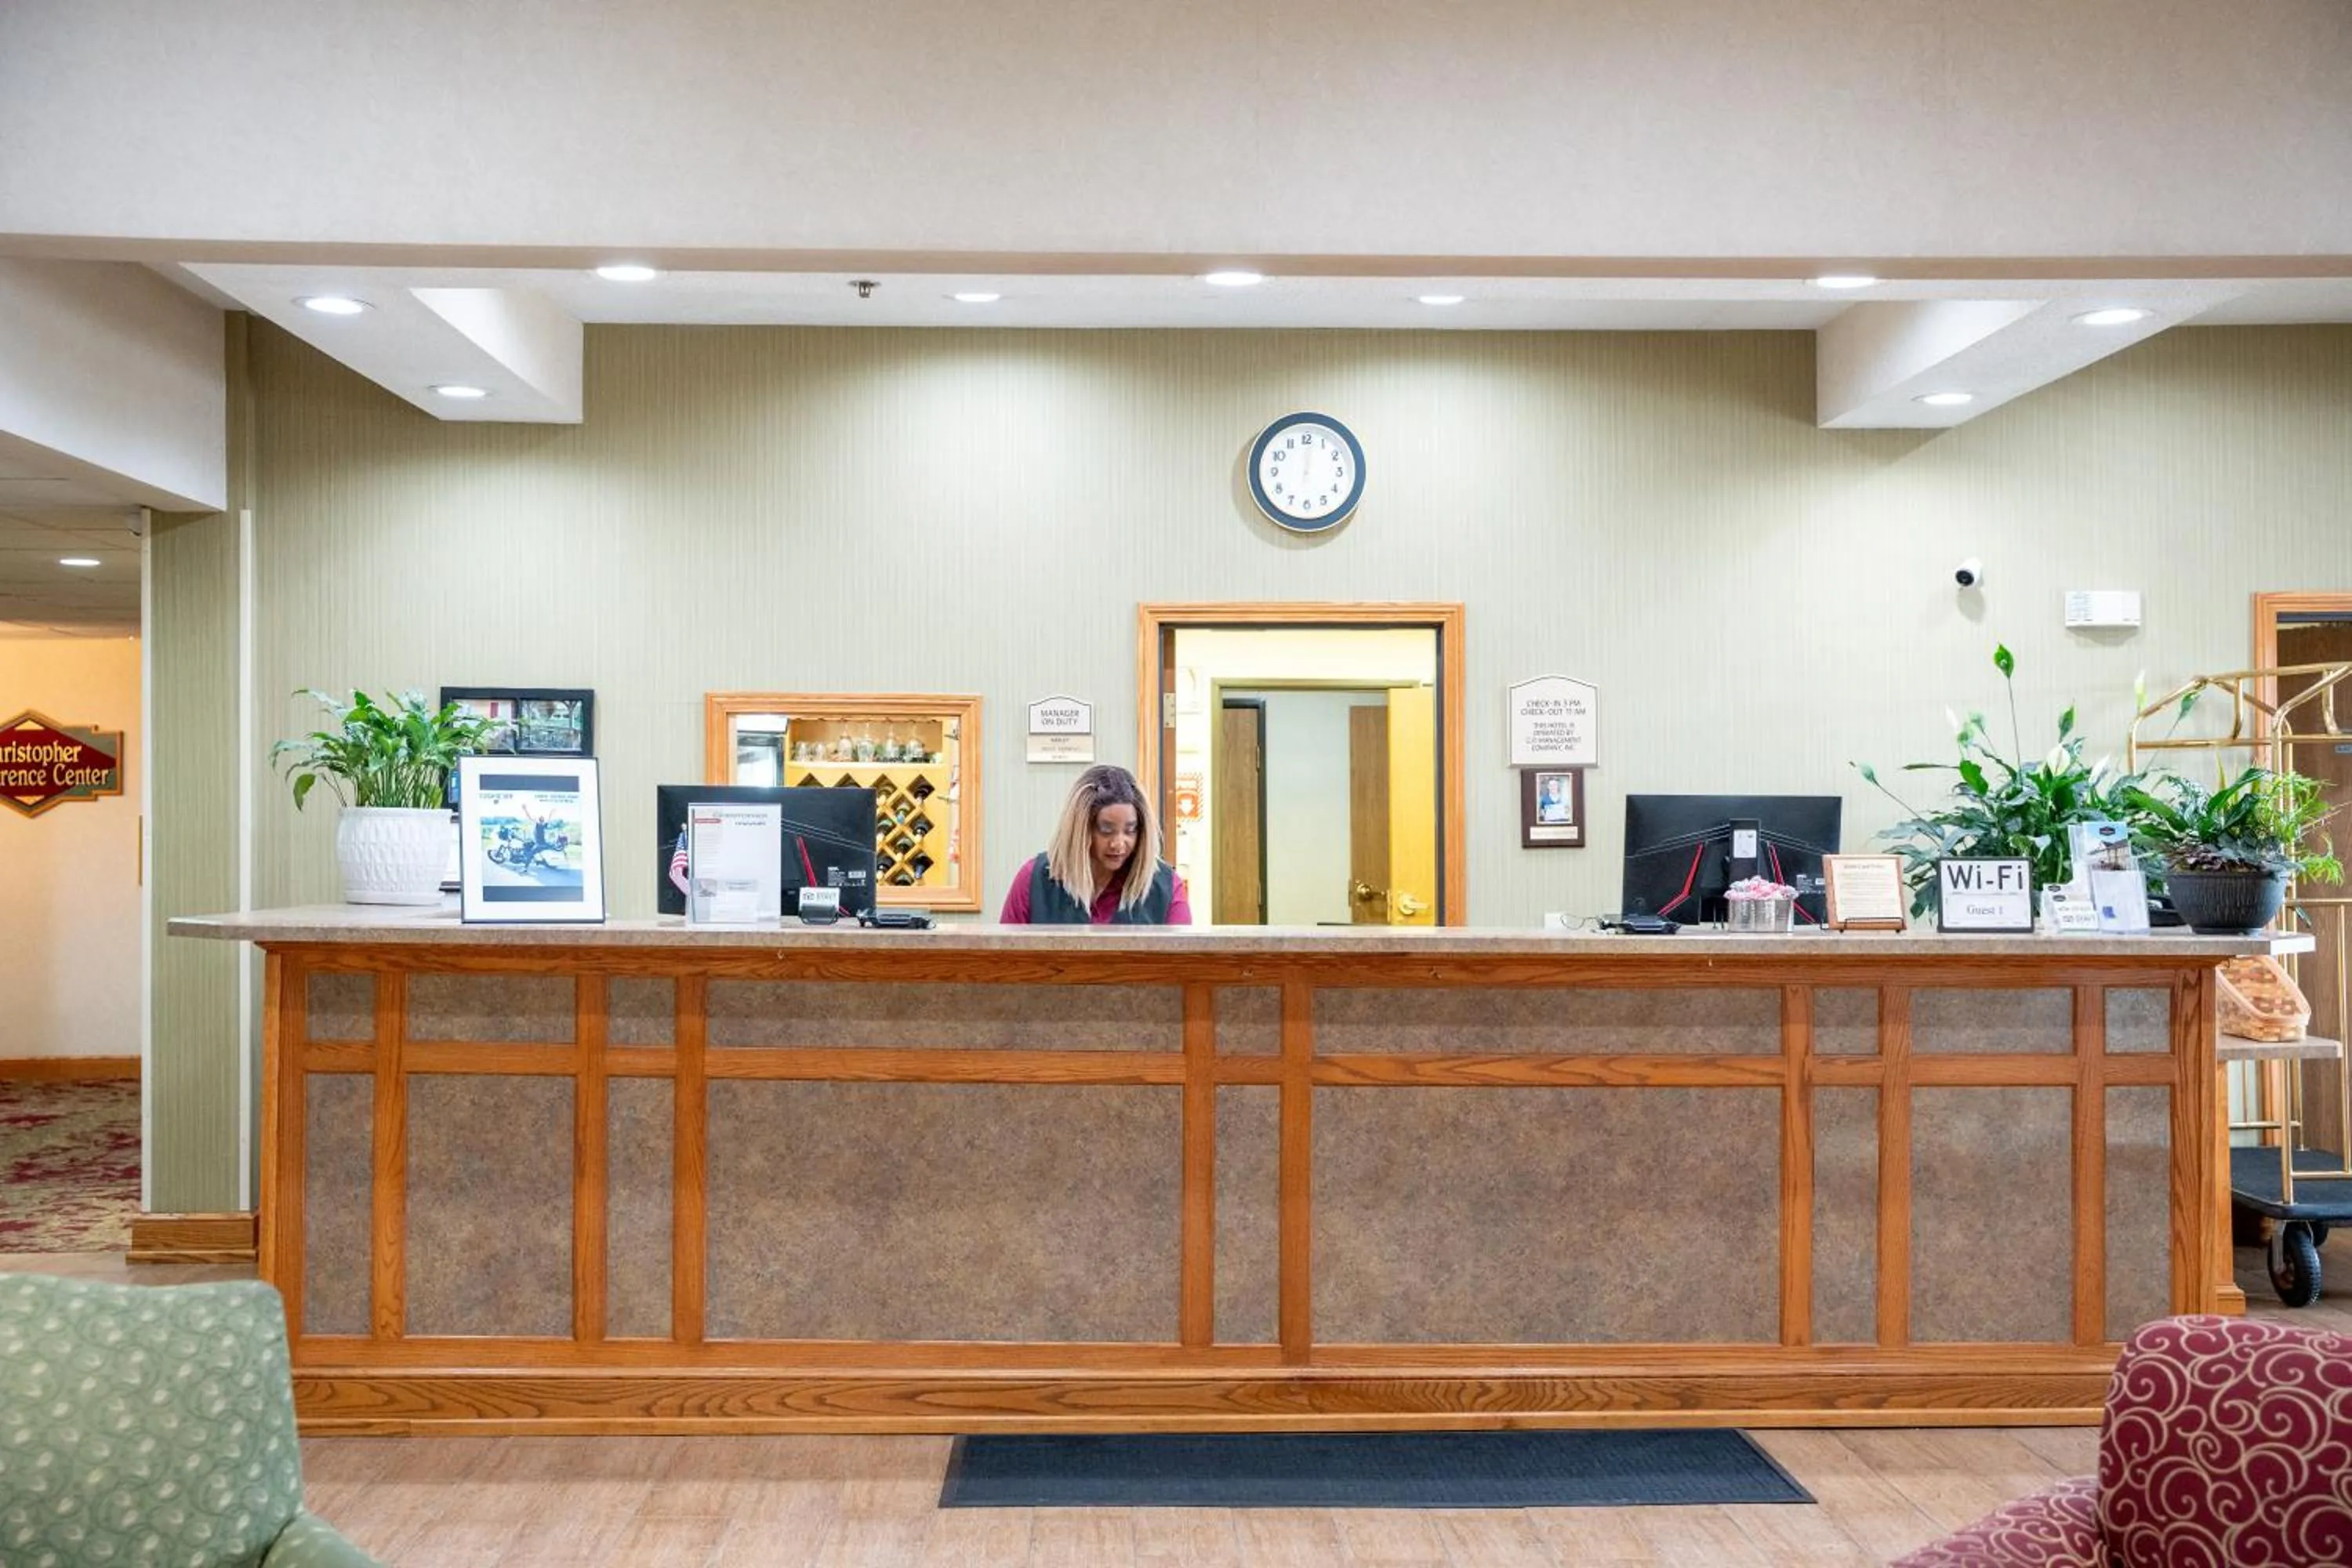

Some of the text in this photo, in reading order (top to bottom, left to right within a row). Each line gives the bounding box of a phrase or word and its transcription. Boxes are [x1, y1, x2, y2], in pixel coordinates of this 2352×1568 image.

[1287, 439, 1294, 448] 11
[1301, 434, 1312, 445] 12
[1273, 451, 1286, 461] 10
[1332, 452, 1339, 461] 2
[1271, 467, 1279, 477] 9
[1336, 467, 1343, 477] 3
[1276, 484, 1283, 494] 8
[1332, 484, 1338, 493] 4
[1287, 495, 1294, 505] 7
[1303, 499, 1311, 510] 6
[1320, 495, 1327, 506] 5
[1574, 707, 1586, 716] AM
[53, 763, 109, 786] Center
[1947, 865, 2024, 890] Wi-Fi
[1966, 904, 1996, 916] Guest
